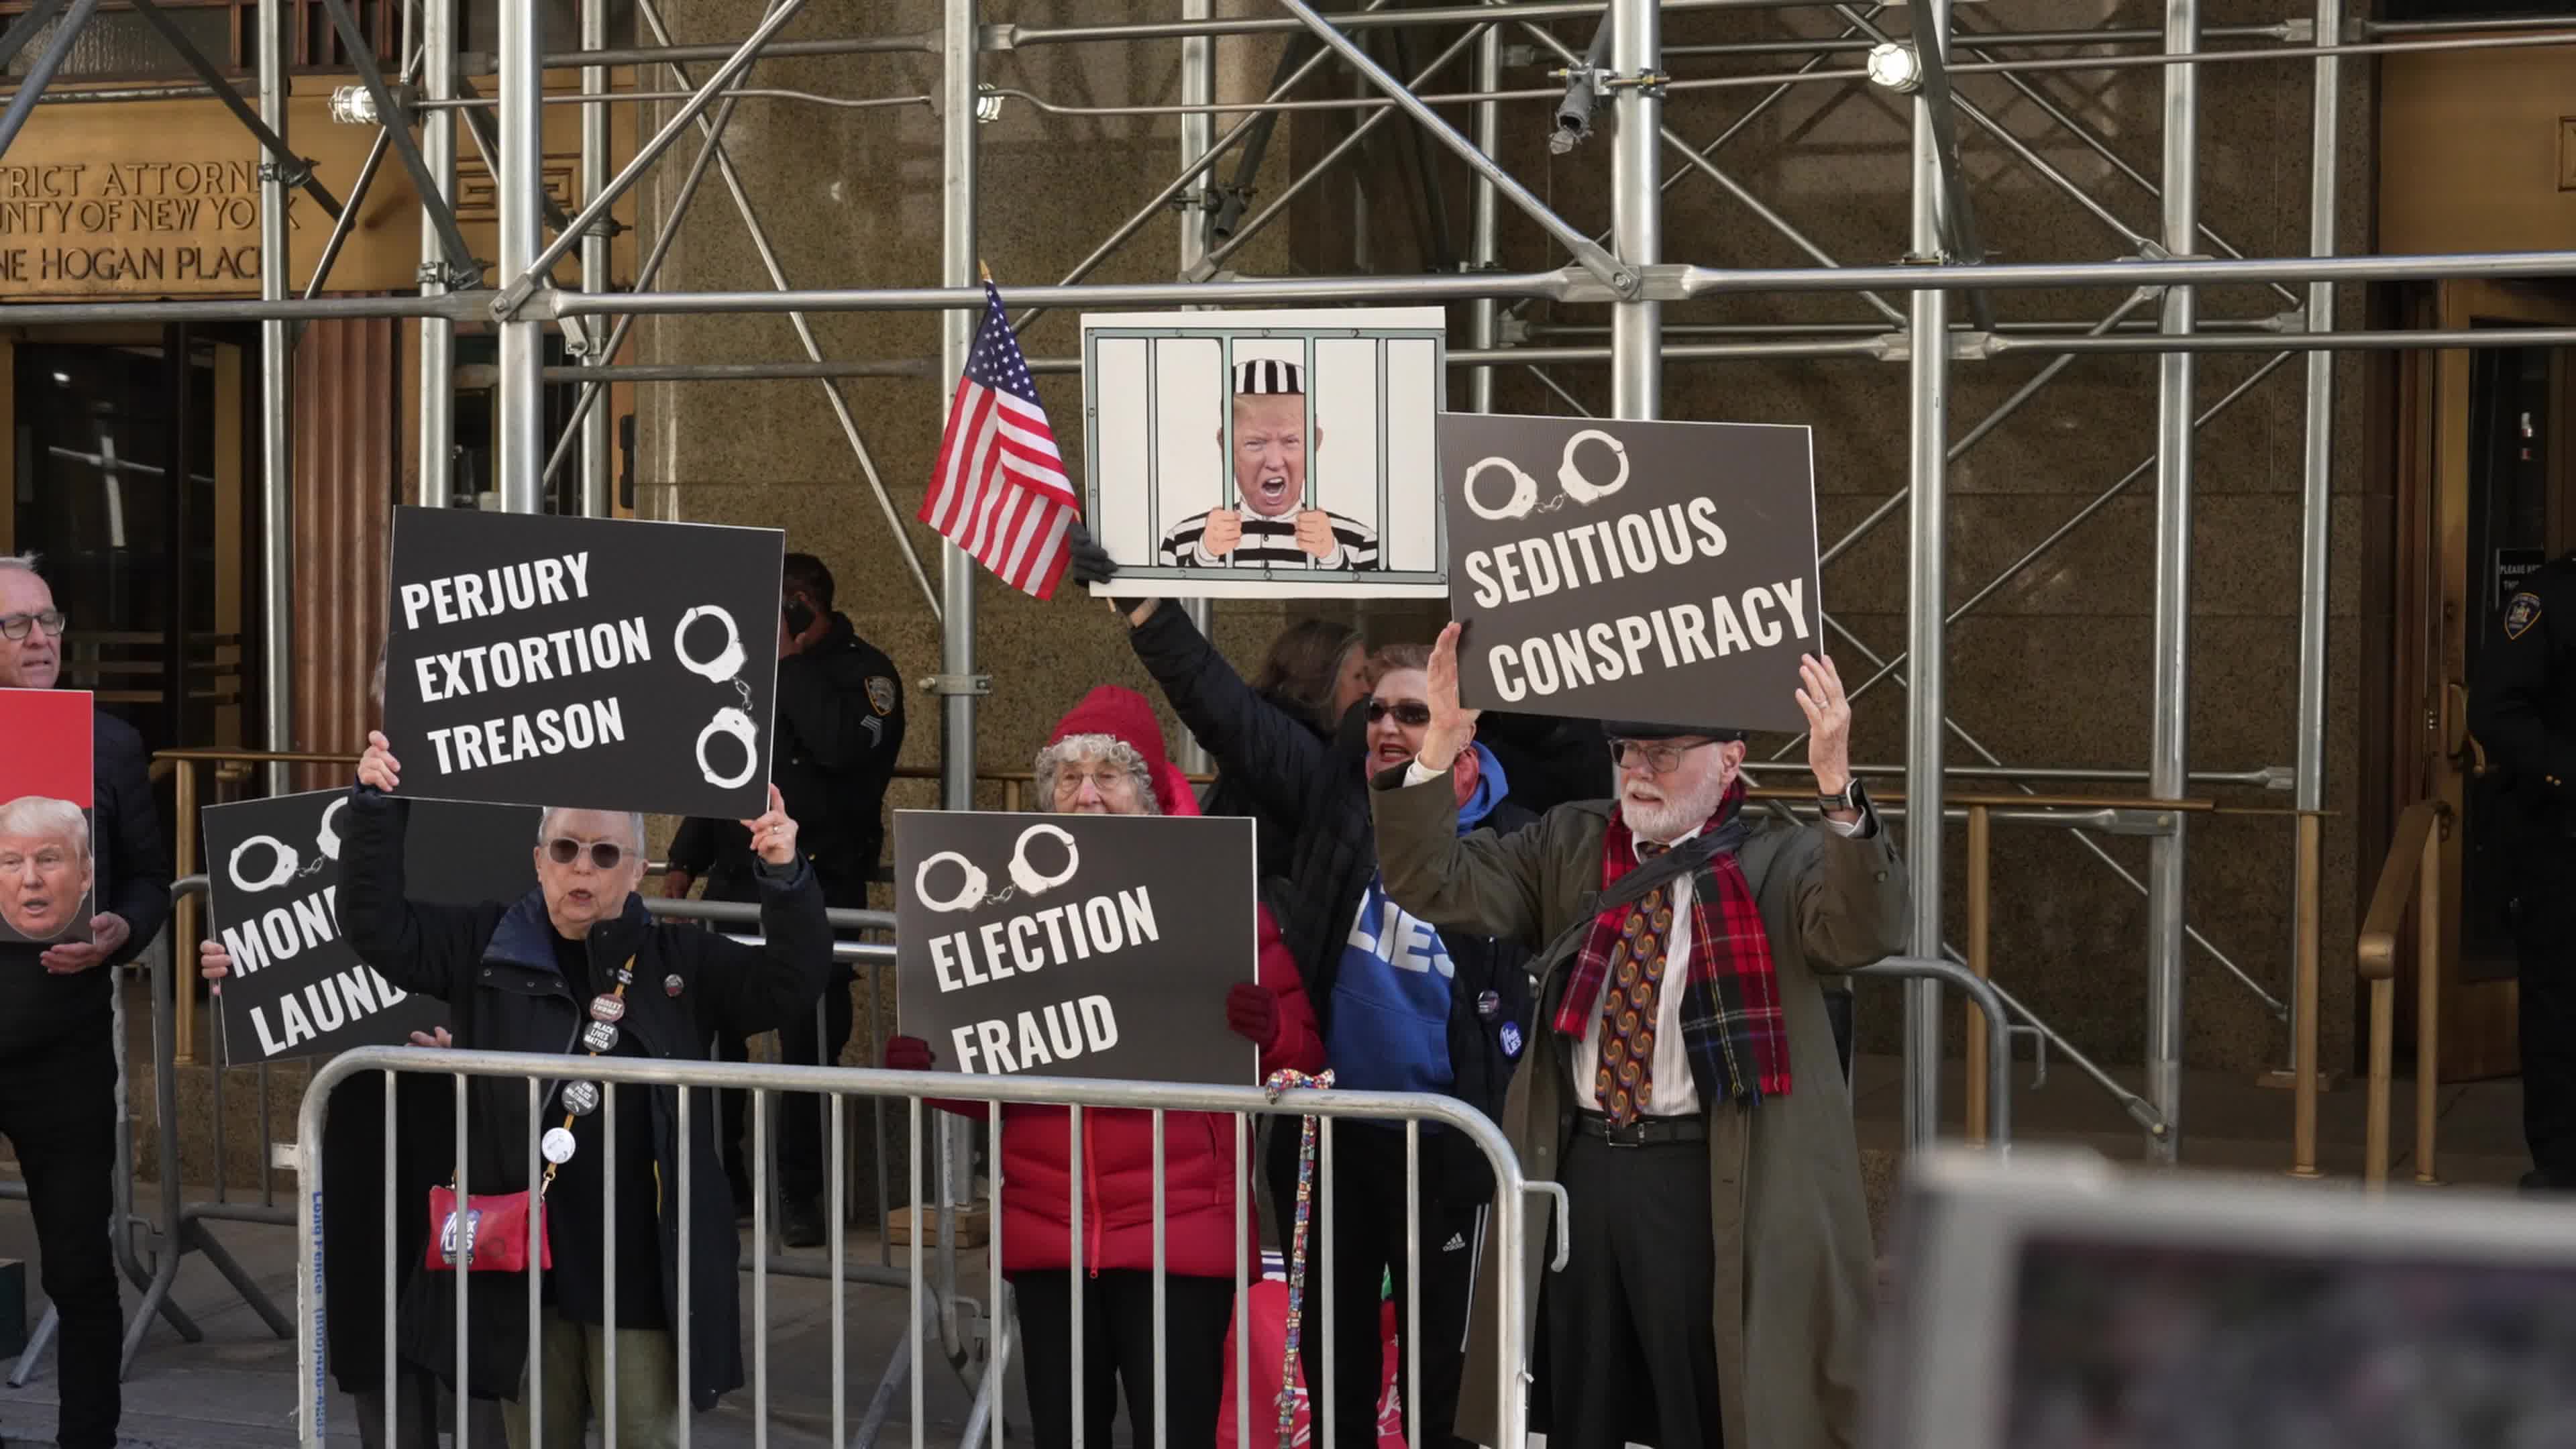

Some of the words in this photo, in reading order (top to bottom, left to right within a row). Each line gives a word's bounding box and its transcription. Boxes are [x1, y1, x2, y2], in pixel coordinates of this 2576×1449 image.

[0, 165, 85, 197] RICT
[0, 201, 73, 233] NTY
[80, 200, 123, 232] OF
[130, 199, 200, 231] NEW
[208, 196, 301, 230] YOK
[41, 248, 163, 280] HOGAN
[400, 551, 588, 630] PERJURY
[1465, 496, 1727, 608] SEDITIOUS
[415, 616, 651, 702] EXTORTION
[1489, 578, 1809, 702] CONSPIRACY
[427, 697, 625, 775] TREASON
[222, 885, 341, 979] MON
[928, 885, 1159, 993] ELECTION
[951, 995, 1119, 1075] FRAUD
[314, 1240, 323, 1294] Fence
[445, 1234, 474, 1251] LIS
